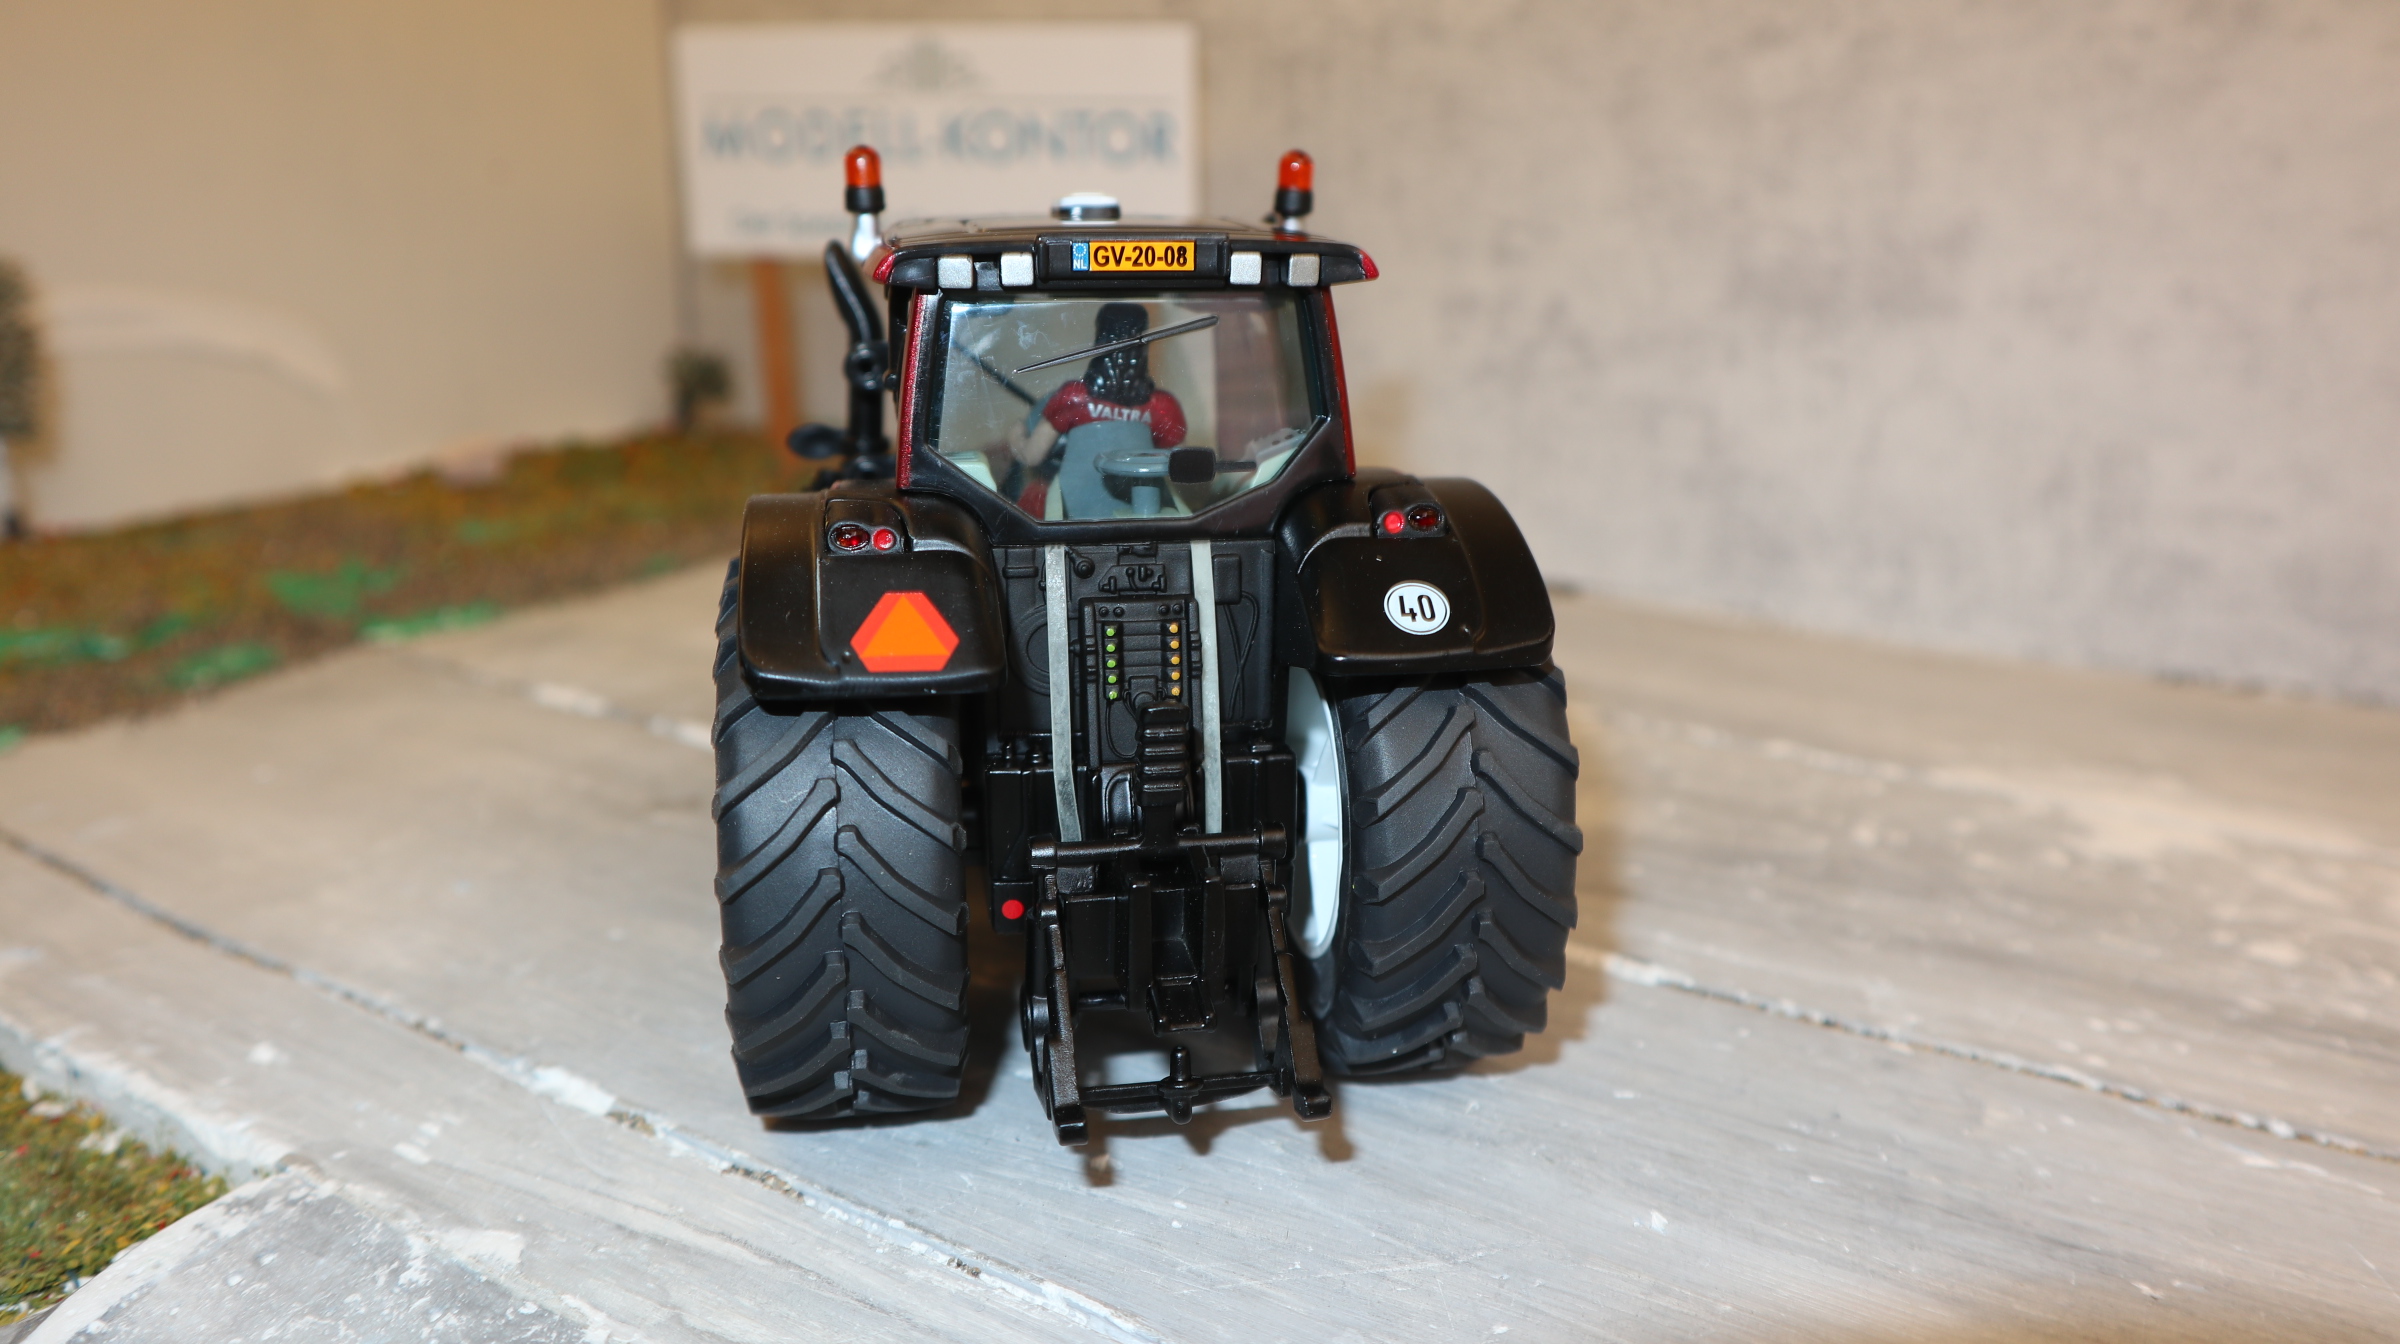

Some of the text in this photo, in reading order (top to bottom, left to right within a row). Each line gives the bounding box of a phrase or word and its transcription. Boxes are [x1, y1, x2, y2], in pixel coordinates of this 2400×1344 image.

[1072, 245, 1188, 270] NL GV-20-08
[1088, 402, 1152, 424] VALTRA
[1398, 594, 1436, 623] 40
